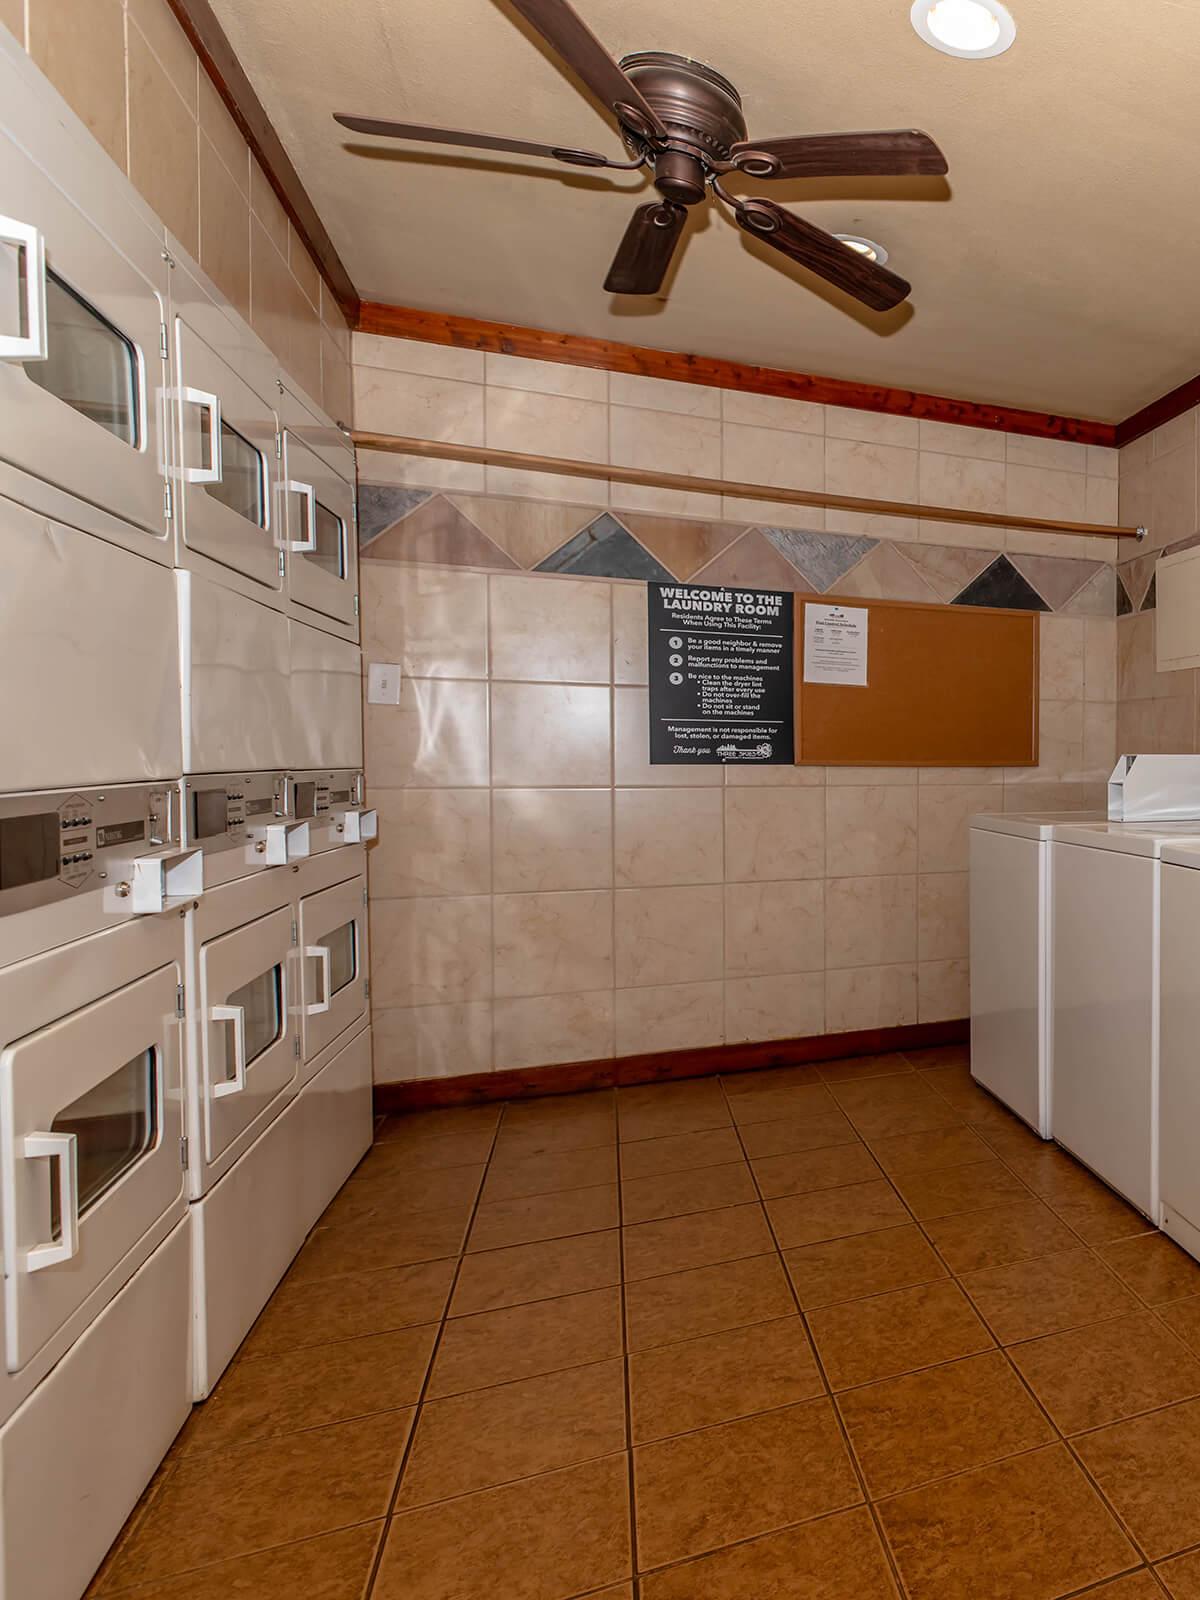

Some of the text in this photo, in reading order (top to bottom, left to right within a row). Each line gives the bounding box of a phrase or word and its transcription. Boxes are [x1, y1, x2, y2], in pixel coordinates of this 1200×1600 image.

[660, 587, 782, 605] WELCOME TO THE
[664, 599, 779, 616] LAUNDRY ROOM
[738, 623, 761, 631] Facility:
[722, 640, 751, 648] neighbor
[688, 661, 728, 669] malfunctions
[737, 680, 751, 688] dryer
[668, 726, 711, 734] Management
[731, 727, 767, 735] responsible
[721, 733, 751, 741] damaged
[673, 745, 711, 755] Thank you
